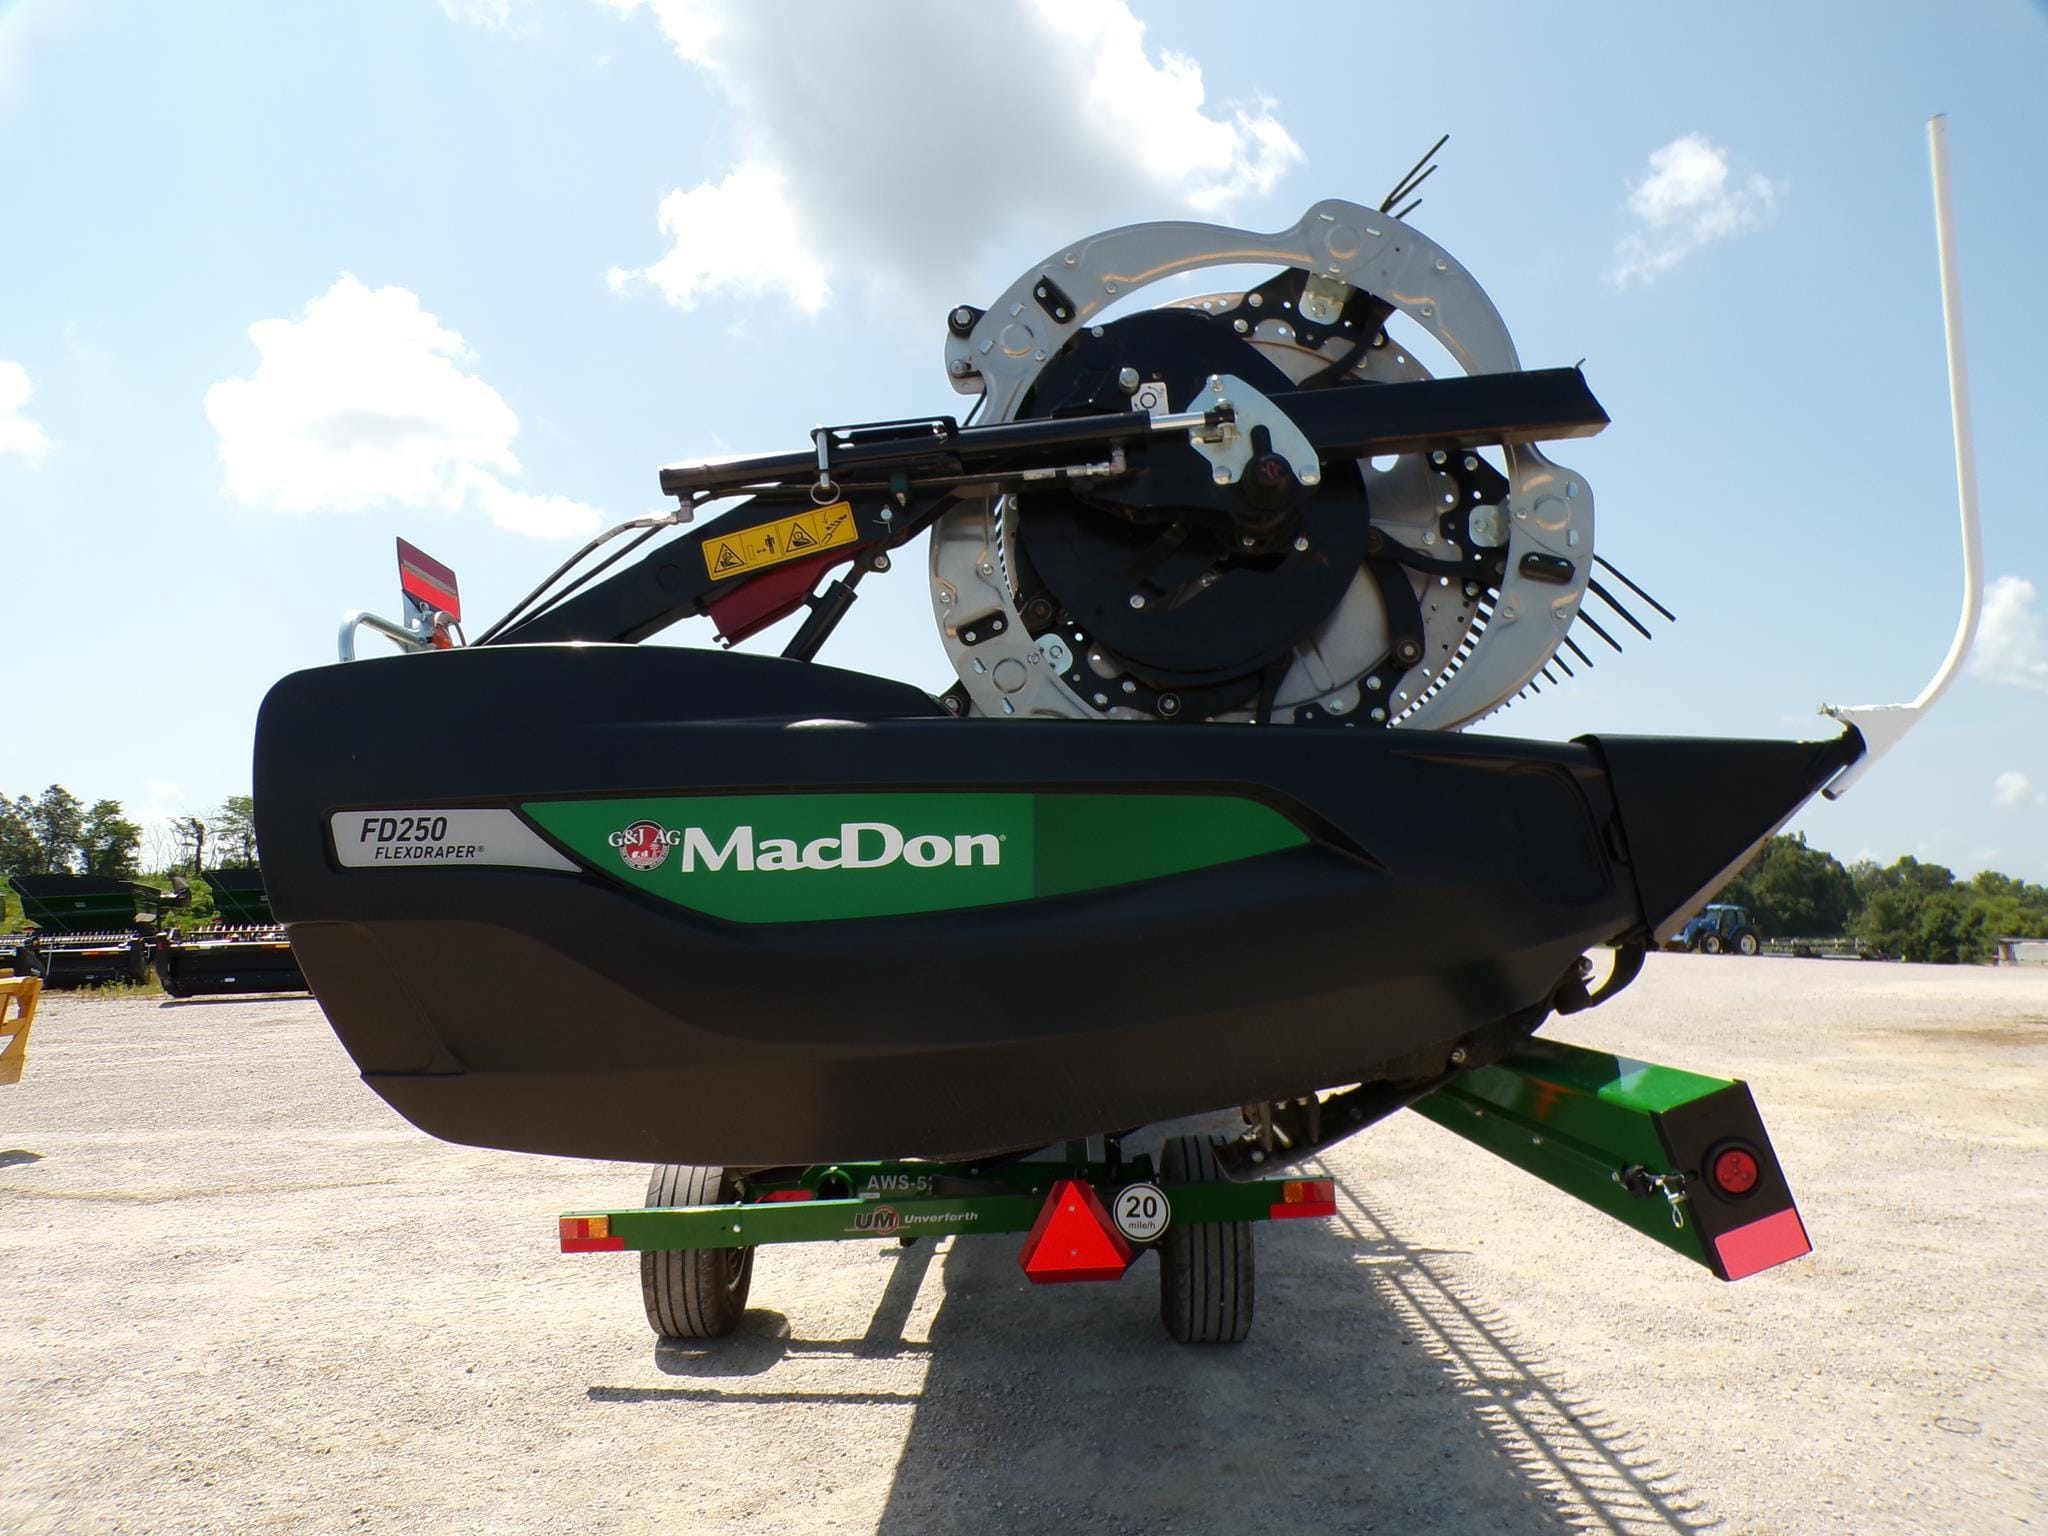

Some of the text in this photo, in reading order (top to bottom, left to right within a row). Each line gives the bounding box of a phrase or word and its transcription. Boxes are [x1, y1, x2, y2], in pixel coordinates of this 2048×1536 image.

[360, 817, 447, 842] FD250
[608, 828, 681, 847] G&J AG
[1126, 1196, 1157, 1218] 20
[904, 1211, 978, 1224] Unverferth
[1128, 1221, 1156, 1230] mile/h
